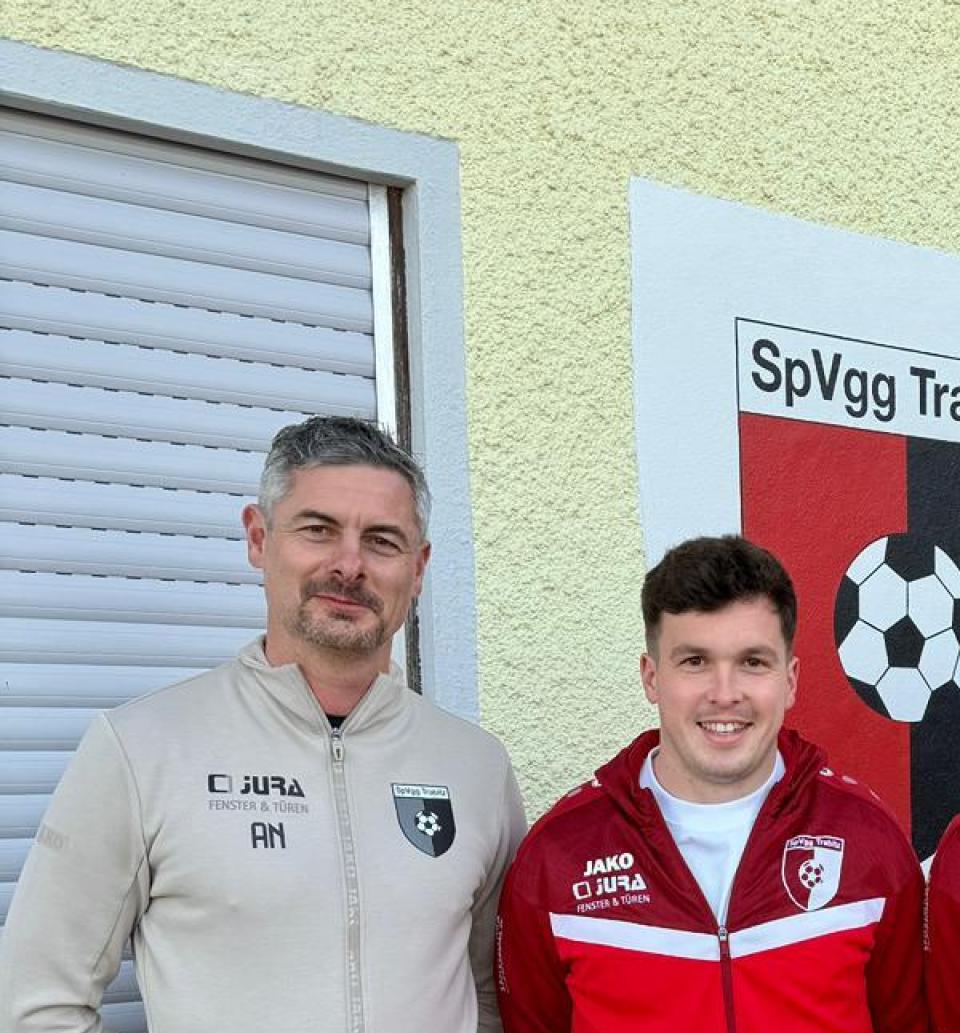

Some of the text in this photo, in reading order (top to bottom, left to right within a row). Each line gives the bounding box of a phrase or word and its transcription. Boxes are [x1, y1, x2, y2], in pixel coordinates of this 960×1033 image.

[751, 338, 897, 422] SpVgg
[208, 800, 309, 814] FENSTER & TÜREN
[251, 822, 286, 848] AN
[583, 852, 634, 877] JAKO
